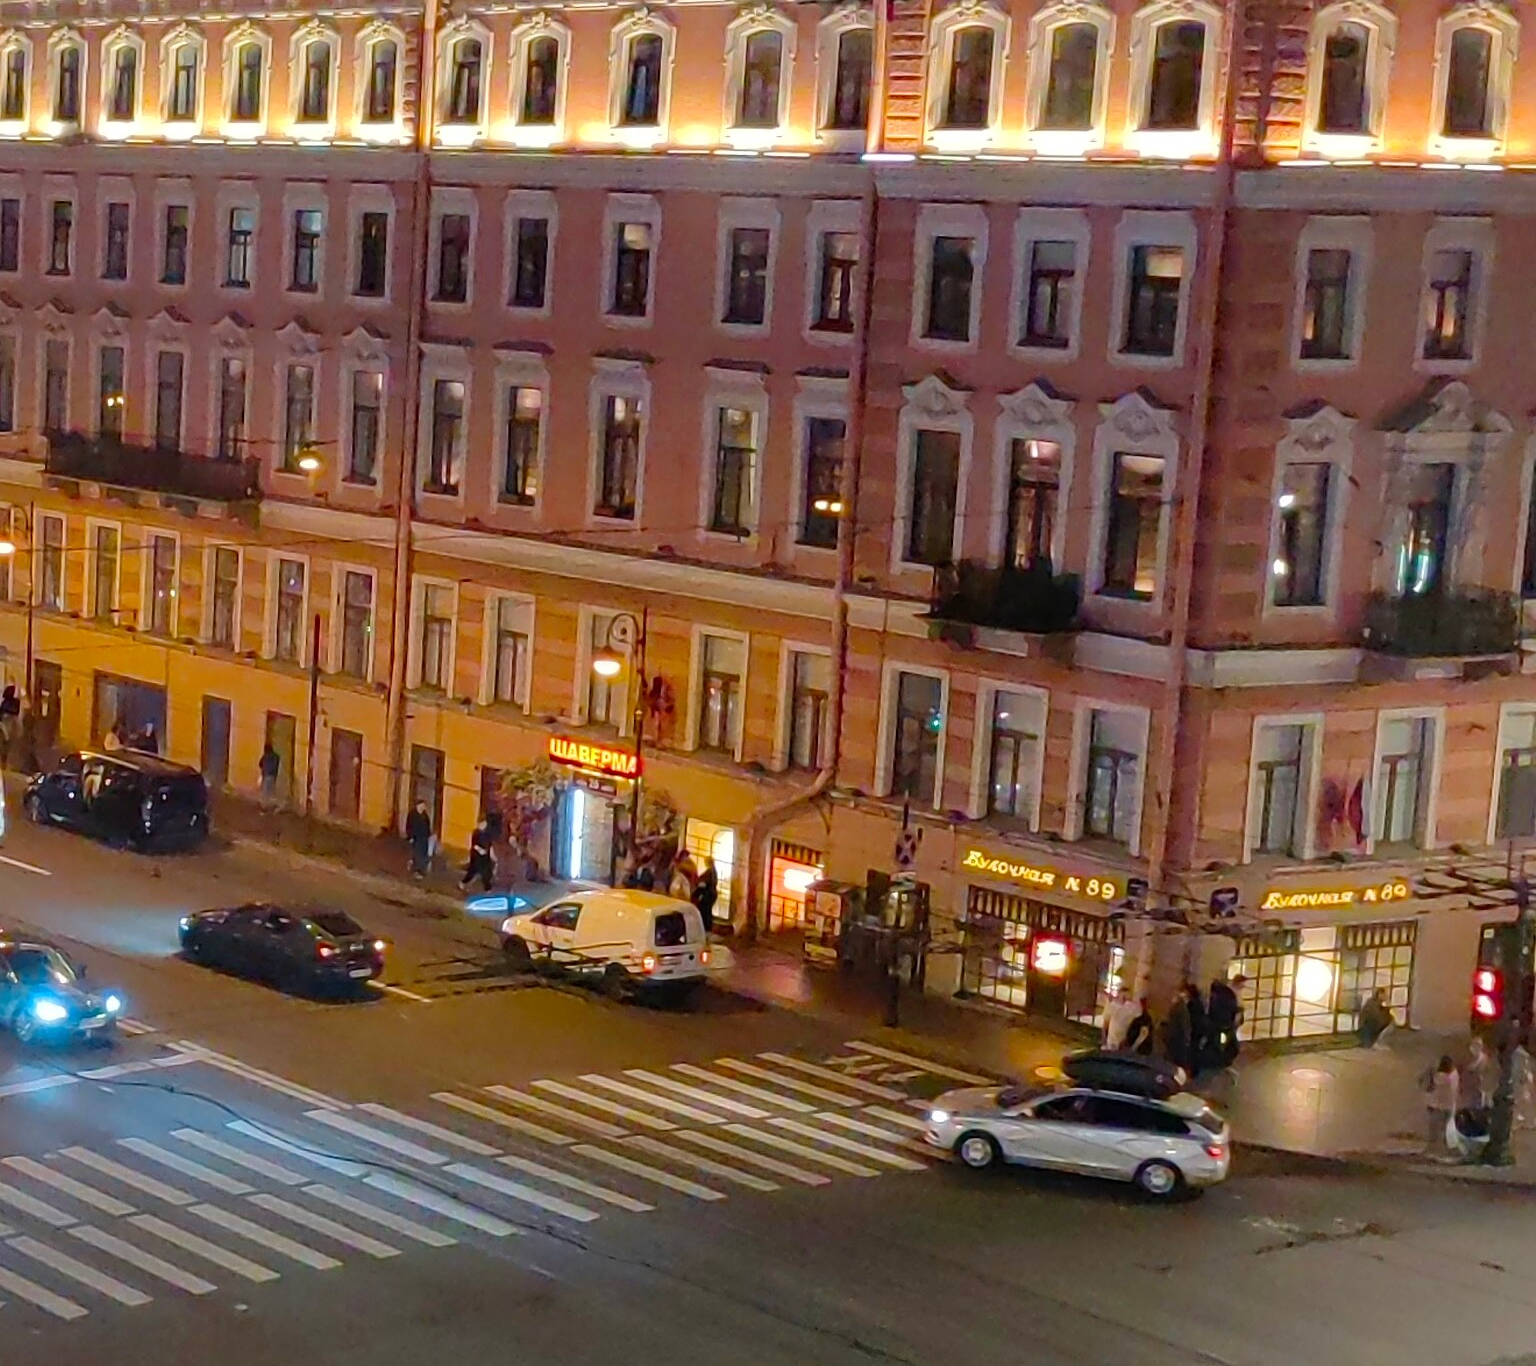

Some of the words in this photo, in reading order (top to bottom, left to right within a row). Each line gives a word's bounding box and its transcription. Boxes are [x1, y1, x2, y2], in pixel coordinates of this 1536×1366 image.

[550, 738, 637, 774] ШАВЕРМА
[963, 850, 1055, 885] Булочная
[1086, 879, 1115, 899] 89
